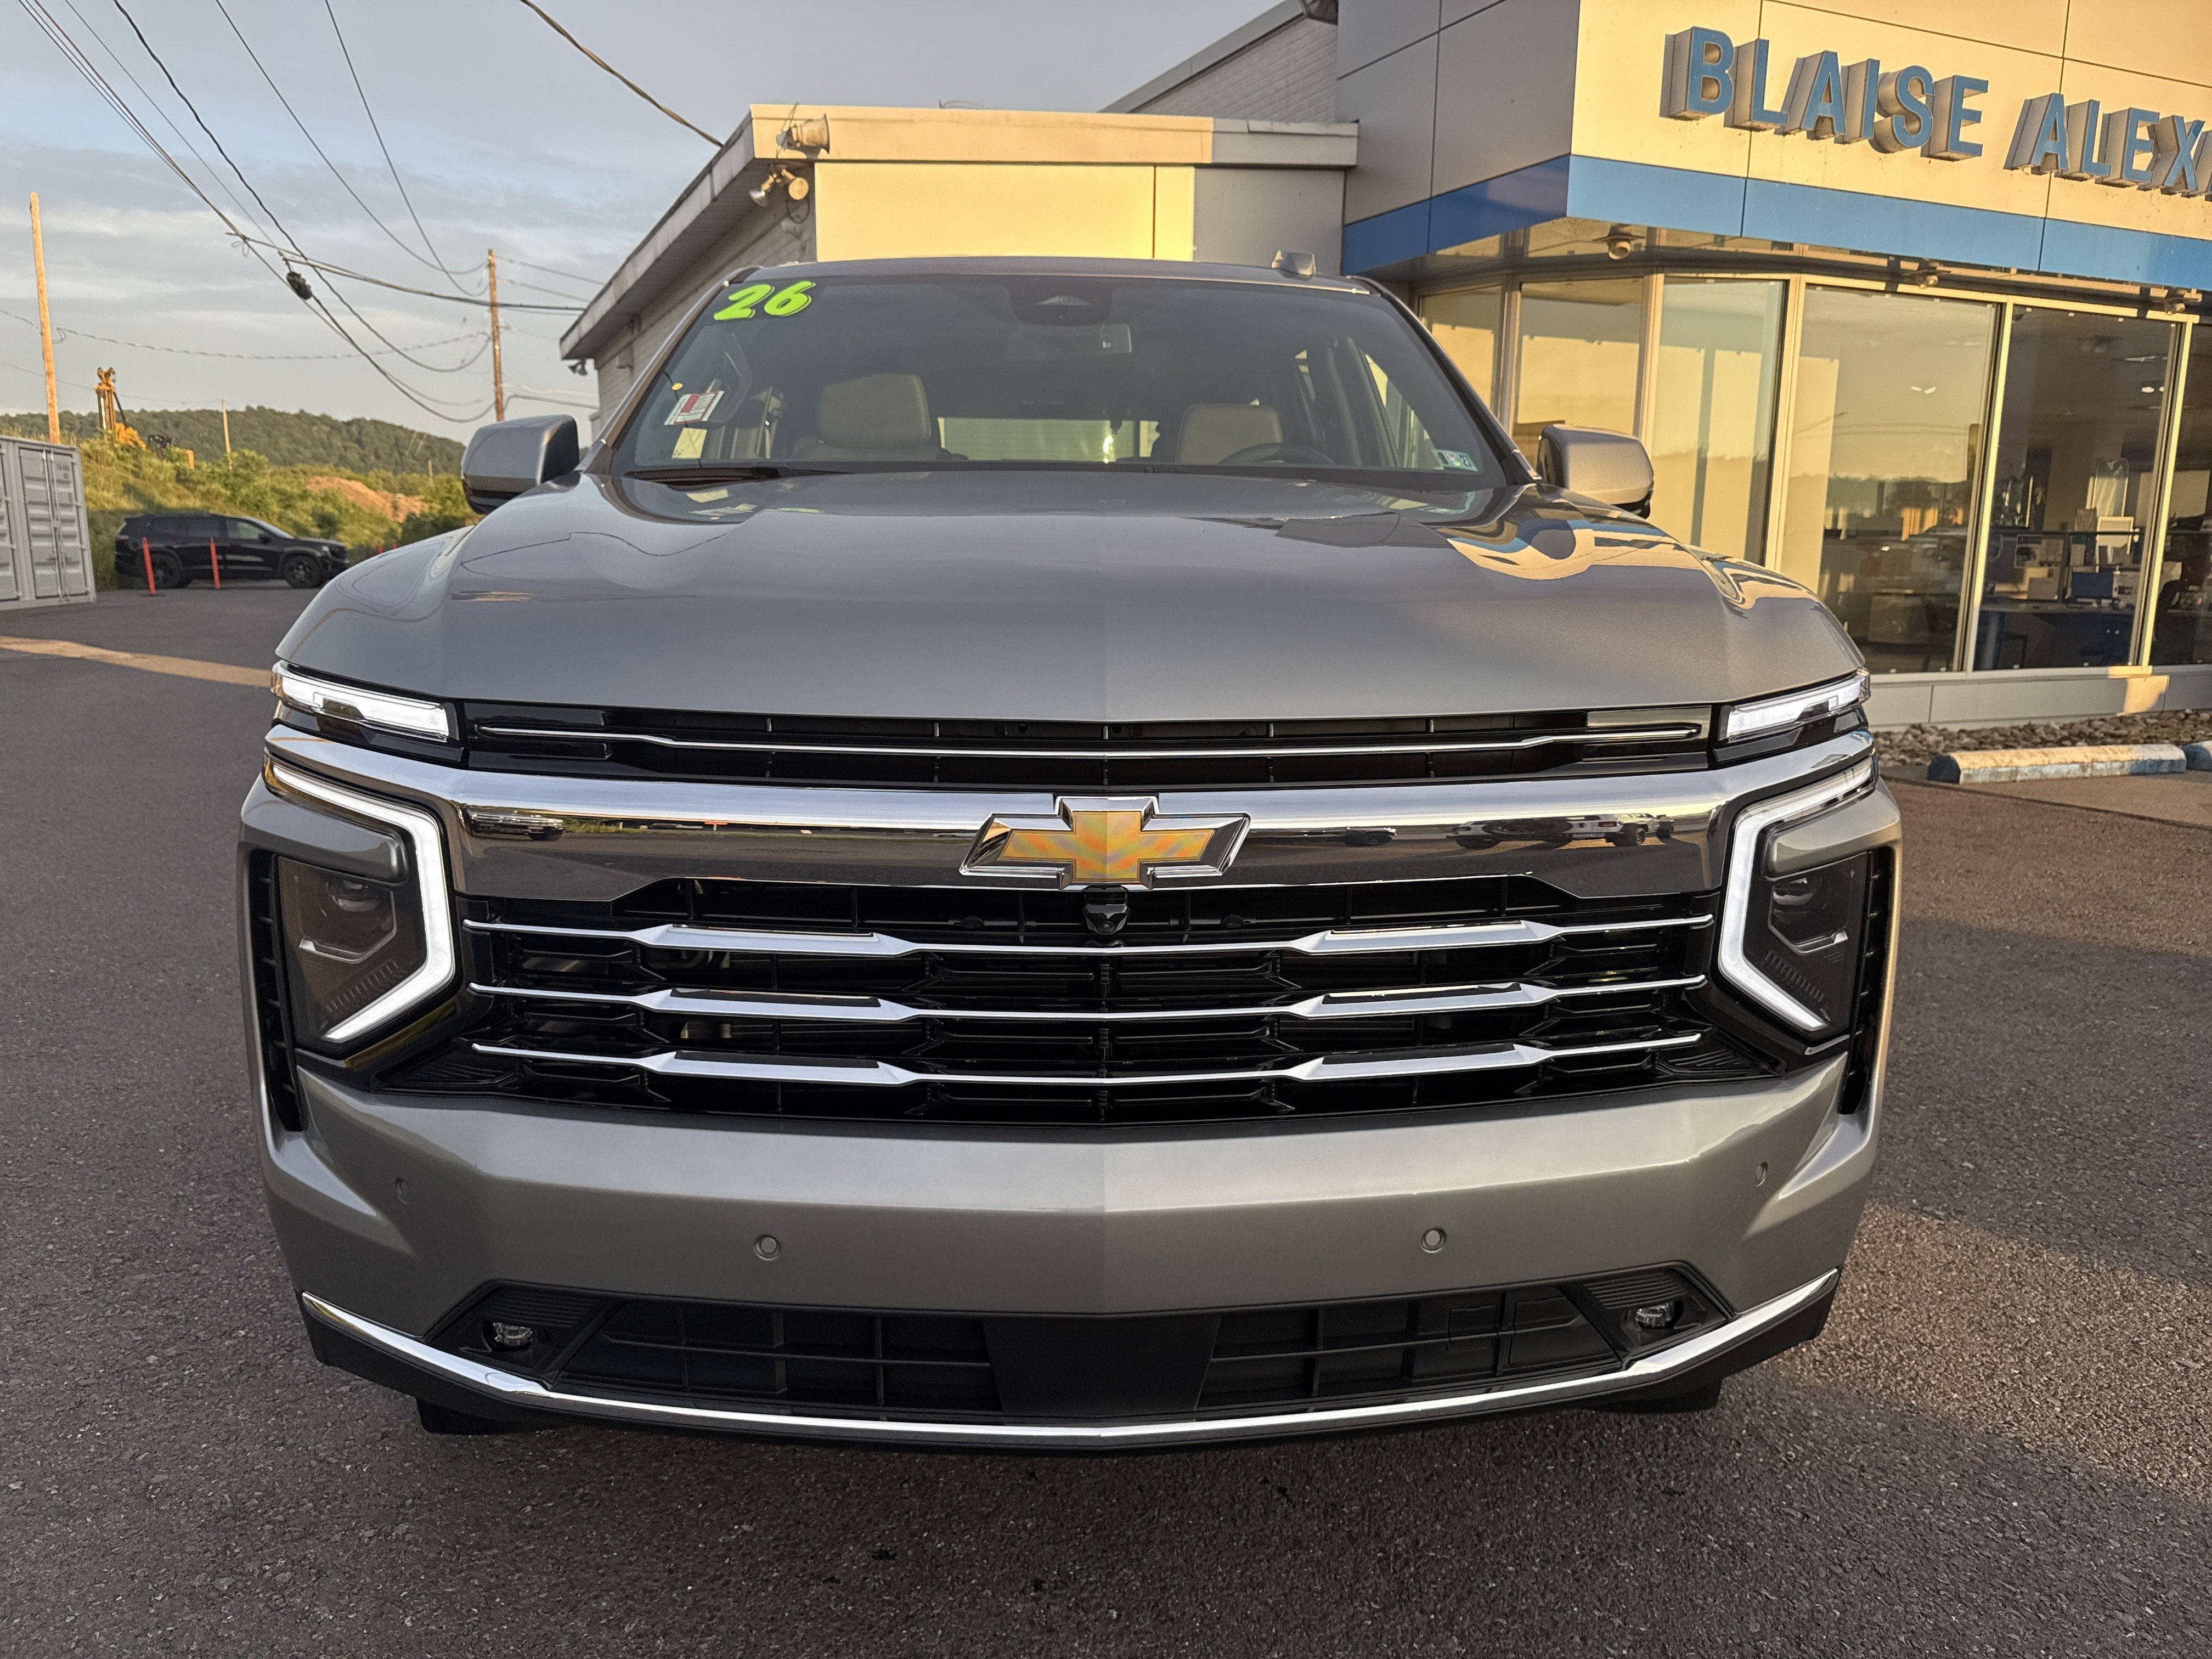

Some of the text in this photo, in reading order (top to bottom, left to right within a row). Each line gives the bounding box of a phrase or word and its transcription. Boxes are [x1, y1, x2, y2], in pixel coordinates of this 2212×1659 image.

[1684, 25, 2212, 193] BLAISE ALEX
[714, 281, 816, 321] 26
